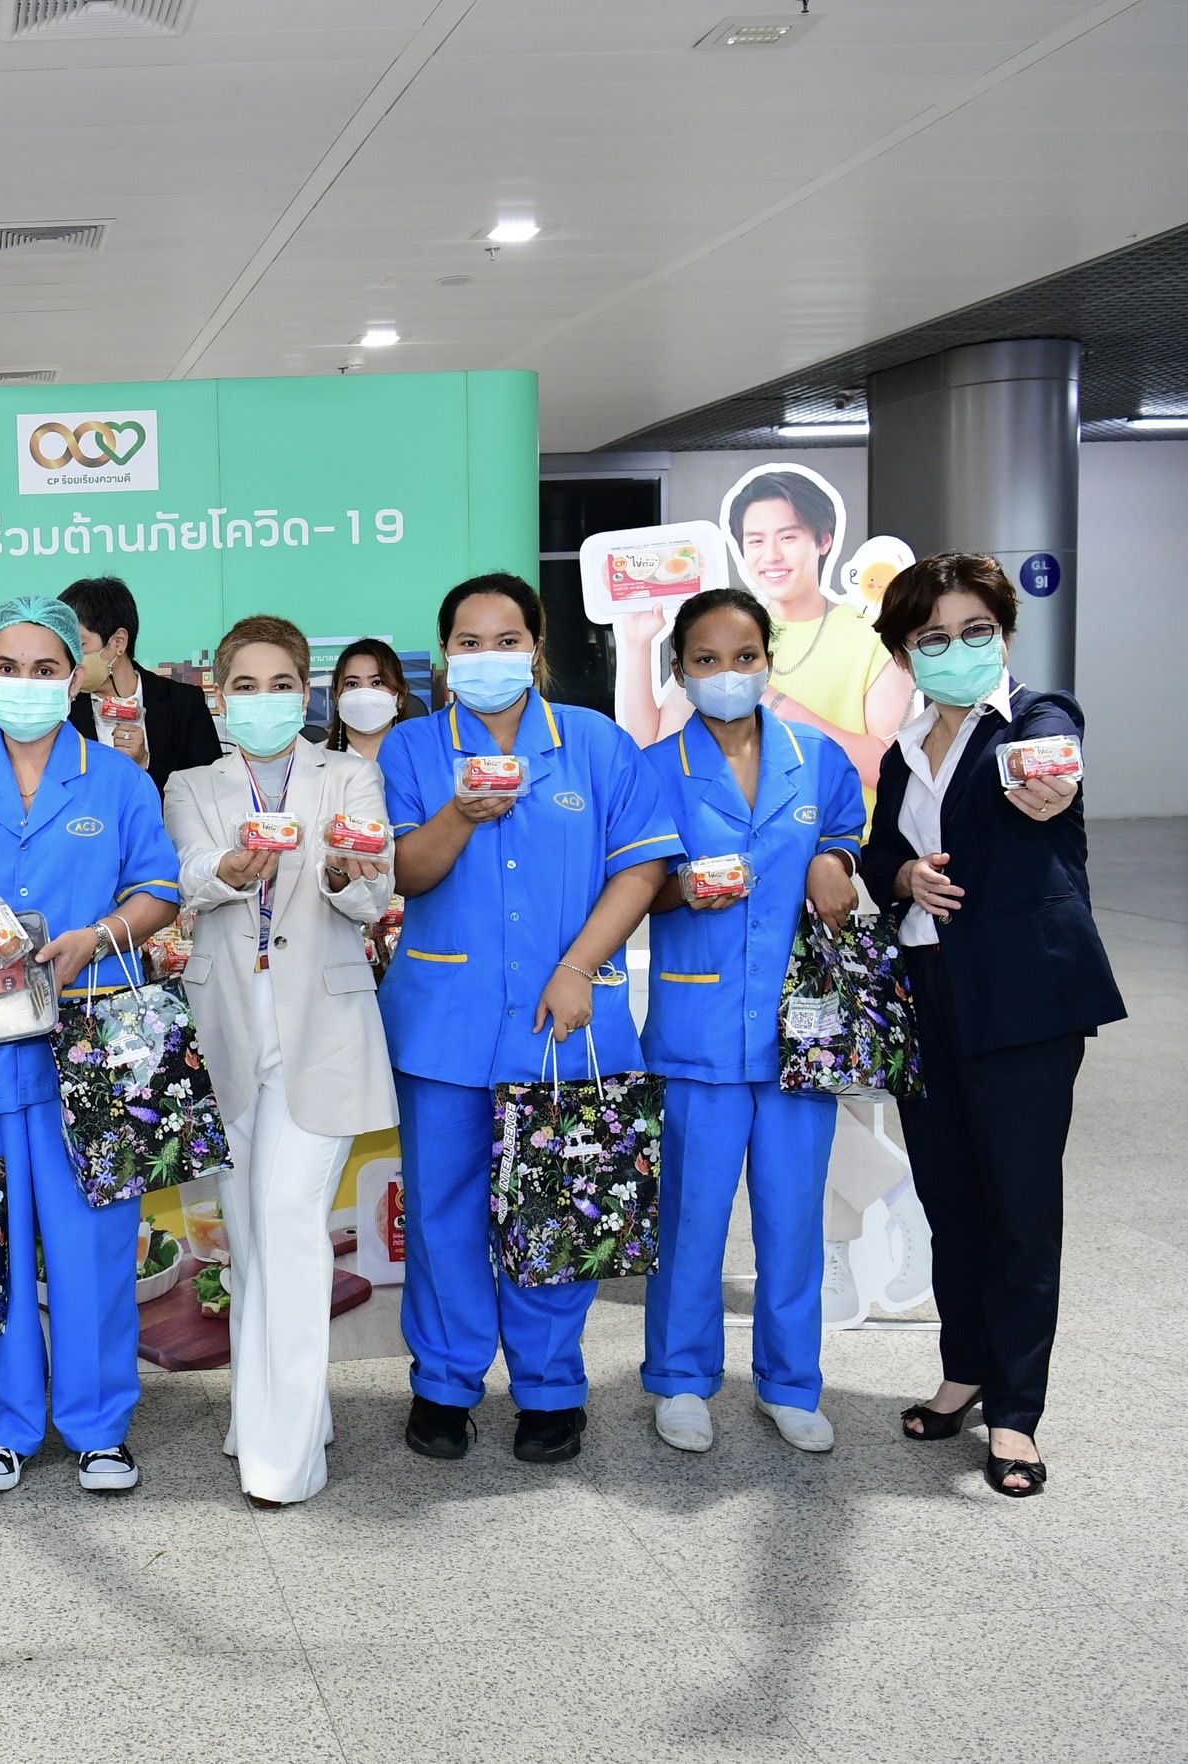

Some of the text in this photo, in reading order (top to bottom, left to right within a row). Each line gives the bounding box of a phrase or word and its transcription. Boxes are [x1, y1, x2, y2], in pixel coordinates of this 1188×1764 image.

[62, 473, 131, 485] ร้อยเรียงความดี
[1035, 575, 1048, 589] 91
[561, 796, 580, 807] ACS
[75, 822, 96, 831] ACS
[498, 1102, 516, 1224] SKIN INTELLIGENCE
